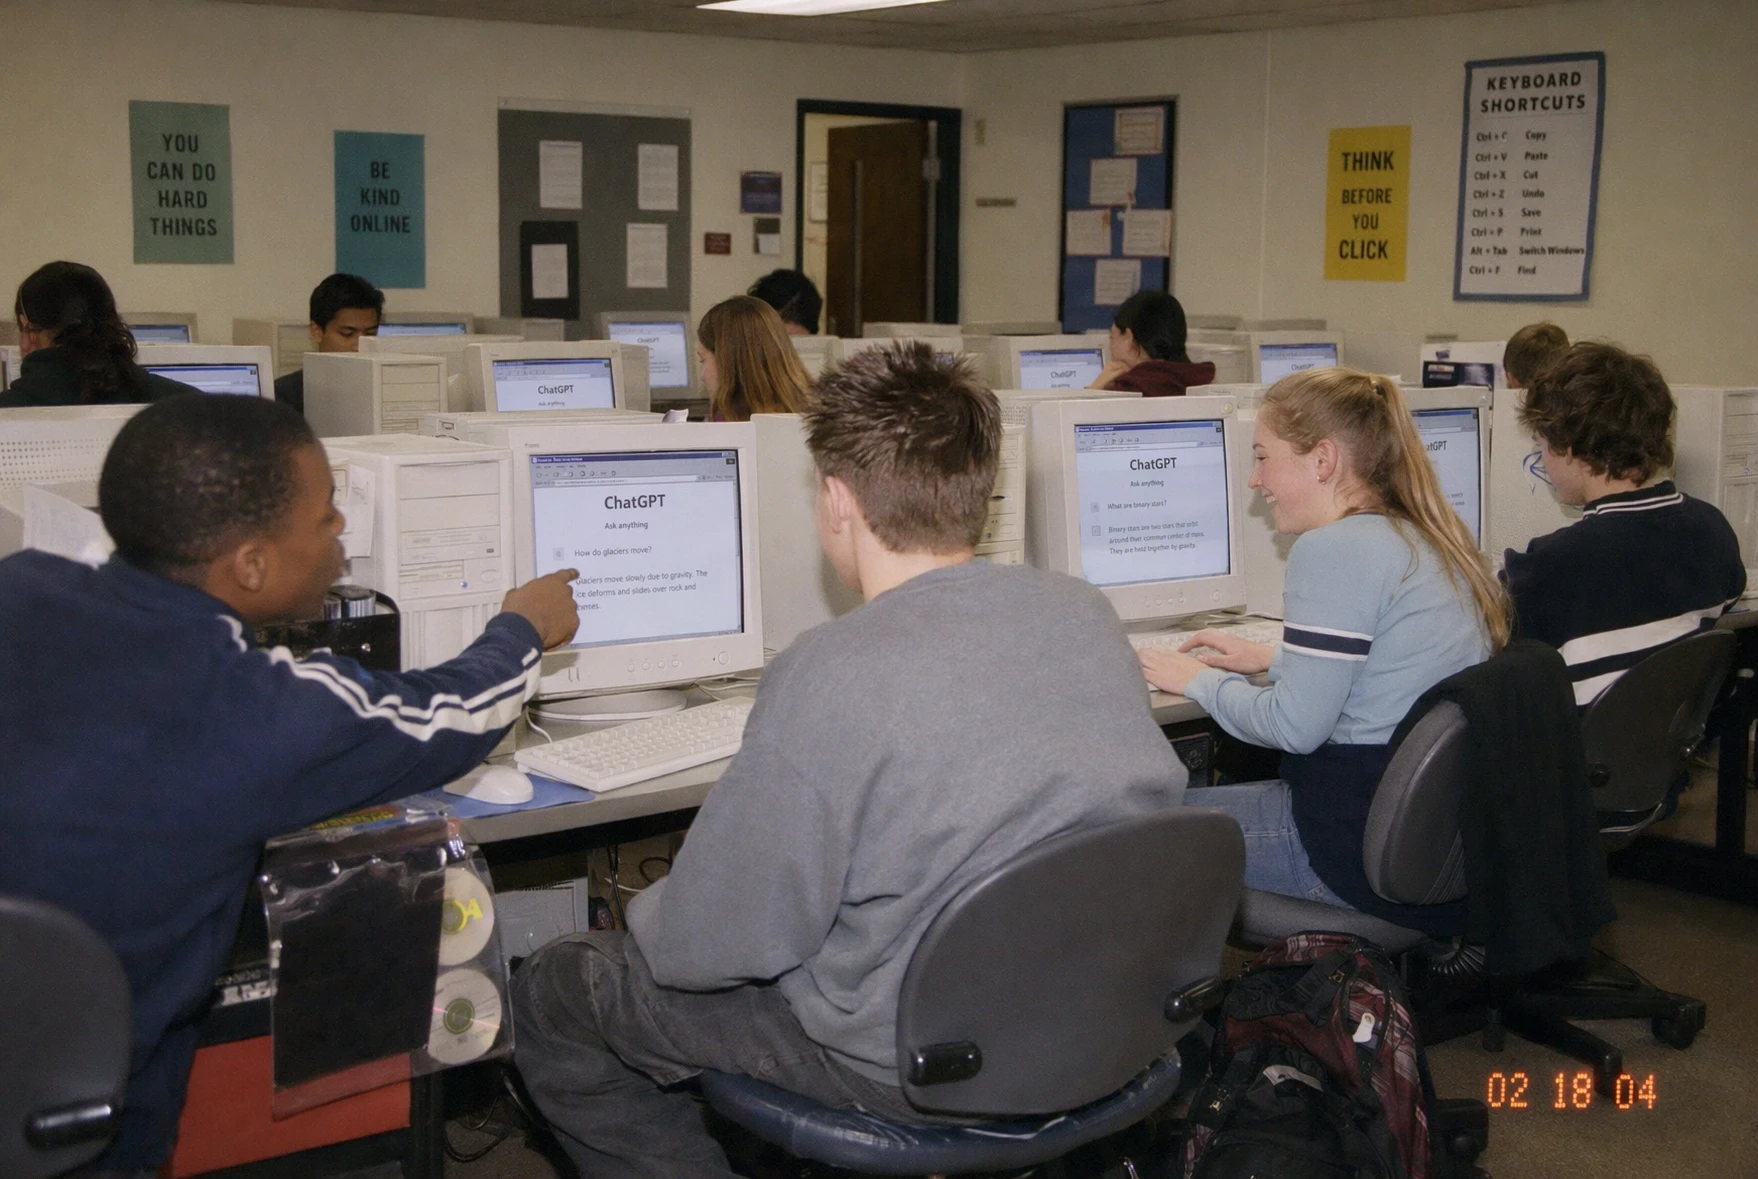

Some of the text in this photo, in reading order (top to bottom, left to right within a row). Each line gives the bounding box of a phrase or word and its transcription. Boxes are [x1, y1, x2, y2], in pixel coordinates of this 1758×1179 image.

[1488, 72, 1582, 91] KEYBOARD
[1480, 95, 1586, 114] SHORTCUTS
[162, 133, 199, 153] YOU
[1476, 132, 1491, 142] Ctrl
[1526, 130, 1547, 141] Copy
[1342, 151, 1394, 171] THINK
[1475, 152, 1491, 162] Ctrl
[1501, 152, 1508, 161] V
[1525, 152, 1548, 161] Paste
[147, 162, 216, 181] CAN DO
[370, 162, 390, 180] BE
[1500, 171, 1506, 180] X
[1523, 170, 1538, 180] Cut
[158, 190, 208, 209] HARD
[360, 188, 400, 206] KIND
[1342, 188, 1393, 205] BEFORE
[1473, 190, 1489, 199] Ctrl
[1499, 189, 1505, 198] Z
[1522, 189, 1545, 198] Undo
[1472, 209, 1488, 218] Ctrl
[1498, 208, 1503, 217] S
[1521, 208, 1541, 217] Save
[150, 217, 218, 237] THINGS
[351, 214, 411, 233] ONLINE
[1353, 214, 1379, 230] YOU
[1471, 227, 1487, 237] Ctrl
[1497, 228, 1503, 236] P
[1520, 227, 1542, 236] Print
[1339, 239, 1388, 260] CLICK
[1470, 246, 1482, 255] Alt
[1492, 246, 1508, 255] Tab
[1519, 246, 1546, 255] Switch
[1548, 246, 1585, 255] Windows
[1469, 265, 1485, 274] Ctrl
[1518, 266, 1536, 274] Find
[538, 384, 574, 395] ChatGPT
[1130, 457, 1177, 471] ChatGPT
[1141, 479, 1164, 488] anything
[604, 494, 666, 510] ChatGPT
[1134, 501, 1150, 509] binary
[619, 521, 648, 530] anything
[603, 547, 629, 556] glaciers
[588, 588, 616, 597] deforms
[632, 586, 650, 594] slides
